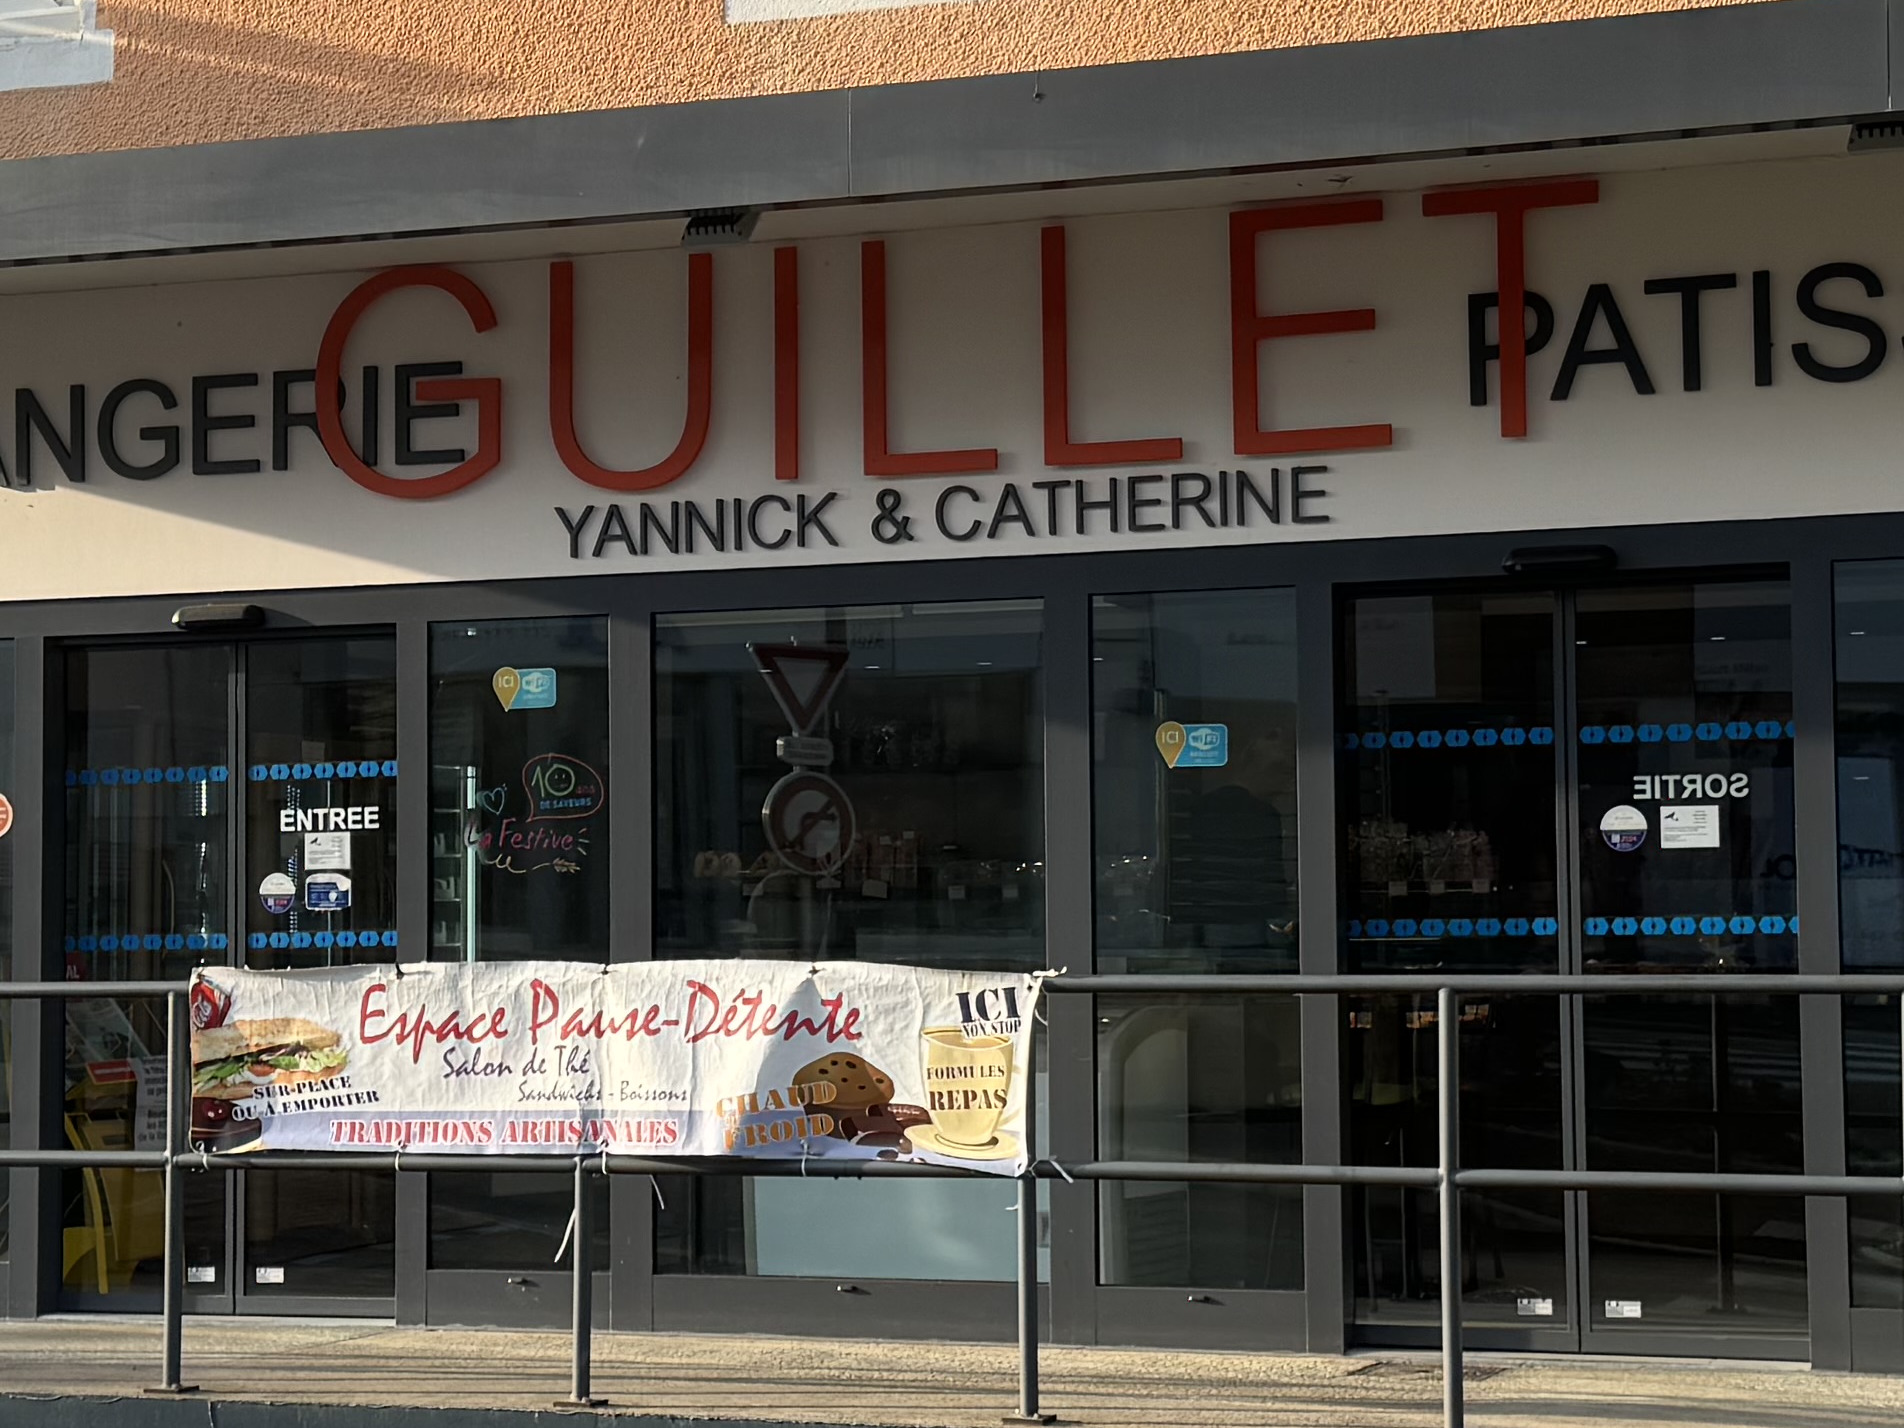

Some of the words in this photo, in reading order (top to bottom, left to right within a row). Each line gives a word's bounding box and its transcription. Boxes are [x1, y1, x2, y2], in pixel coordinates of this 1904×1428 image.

[314, 177, 1601, 502] GUILLET
[554, 490, 841, 560] YANNICK
[869, 487, 916, 546] &
[934, 463, 1332, 544] CATHERINE
[1161, 731, 1179, 744] ICI
[531, 763, 576, 798] 10
[280, 806, 380, 833] ENTREE
[498, 818, 575, 851] Festive
[359, 983, 509, 1065] Espace
[530, 977, 864, 1046] Pause-Détente
[955, 986, 1021, 1024] ICI
[962, 1019, 990, 1038] NON
[991, 1018, 1022, 1035] STOP
[443, 1047, 513, 1079] Salon
[522, 1047, 547, 1076] de
[554, 1045, 591, 1076] Thé
[926, 1065, 1005, 1080] FORMULES
[232, 1104, 258, 1121] OU
[281, 1090, 380, 1115] EMPORTER
[620, 1080, 688, 1102] Boissons
[716, 1080, 838, 1118] CHAUD
[929, 1088, 1008, 1111] REPAS
[331, 1118, 494, 1146] TRADITIONS
[501, 1118, 679, 1145] ARTISANALES
[723, 1113, 835, 1150] FROID
